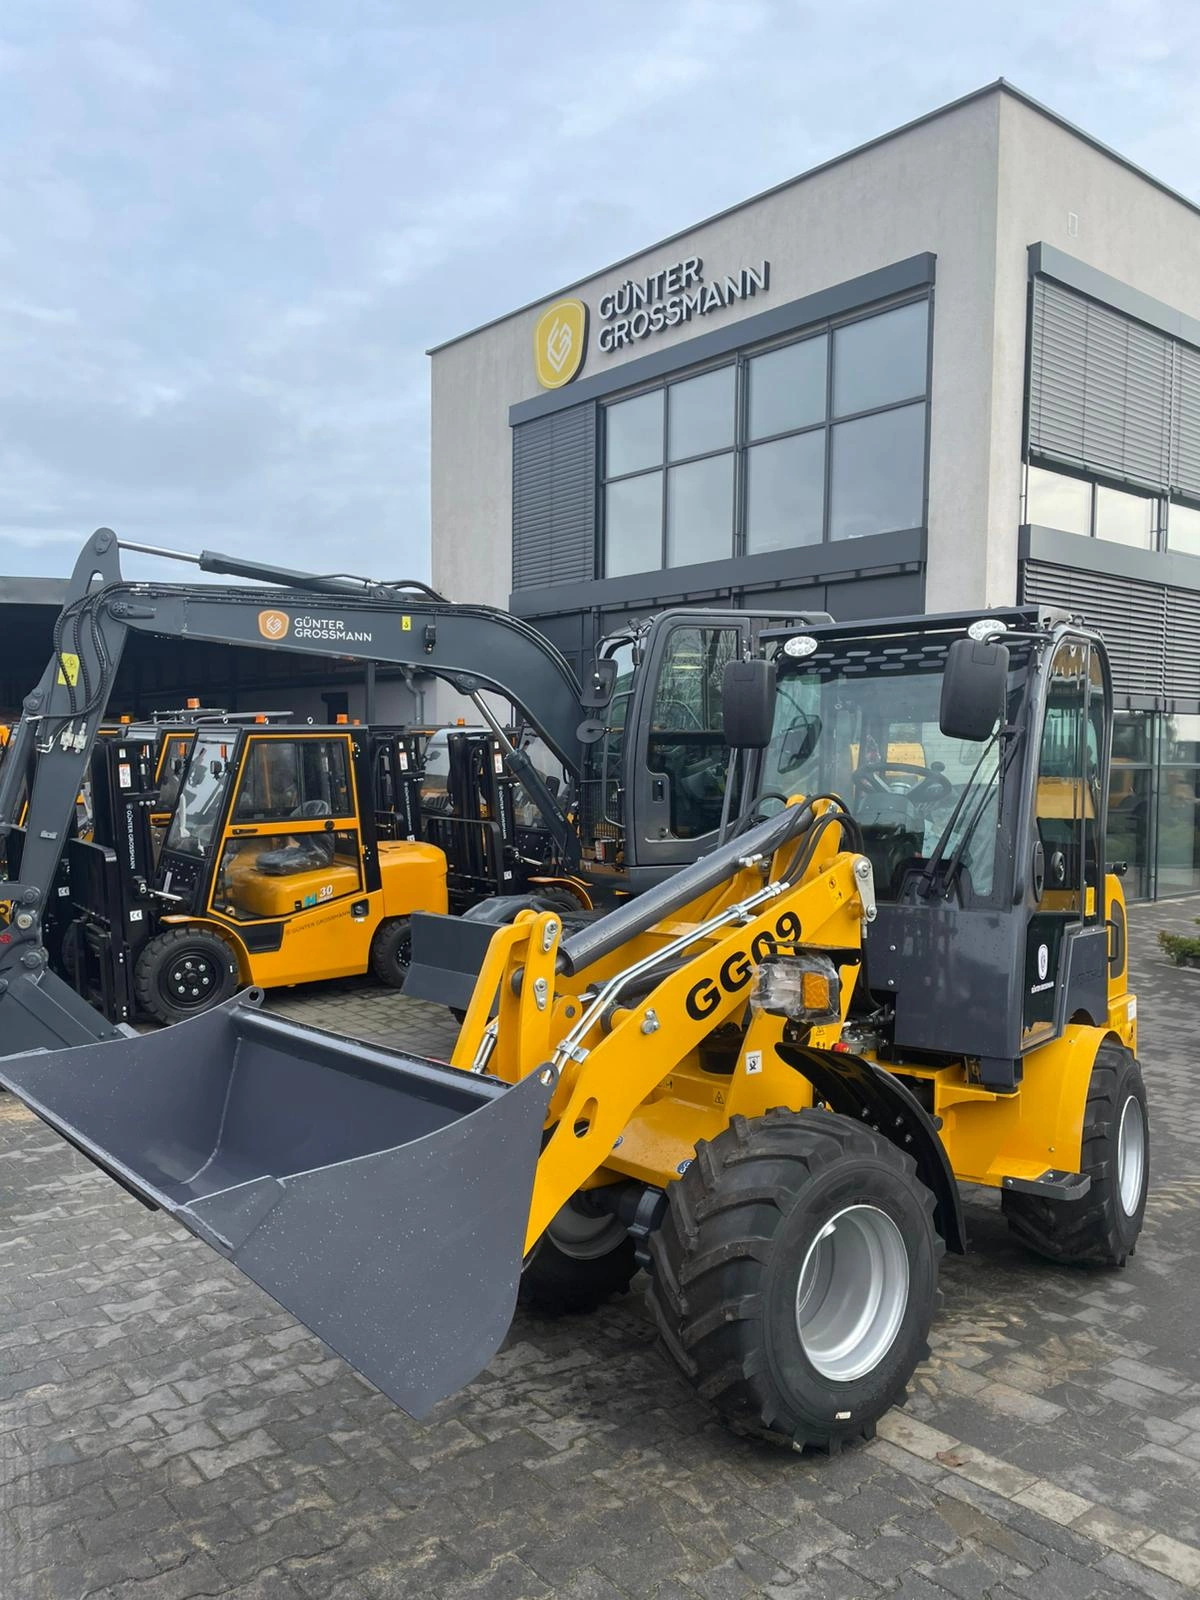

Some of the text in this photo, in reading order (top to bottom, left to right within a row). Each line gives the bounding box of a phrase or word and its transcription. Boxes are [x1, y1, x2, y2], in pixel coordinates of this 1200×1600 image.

[598, 256, 703, 321] GÜNTER
[598, 260, 771, 353] GROSSMANN
[294, 616, 345, 630] GÜNTER
[294, 628, 372, 642] GROSSMANN
[319, 884, 333, 898] 30
[131, 911, 142, 920] CE
[686, 911, 802, 1021] GG09
